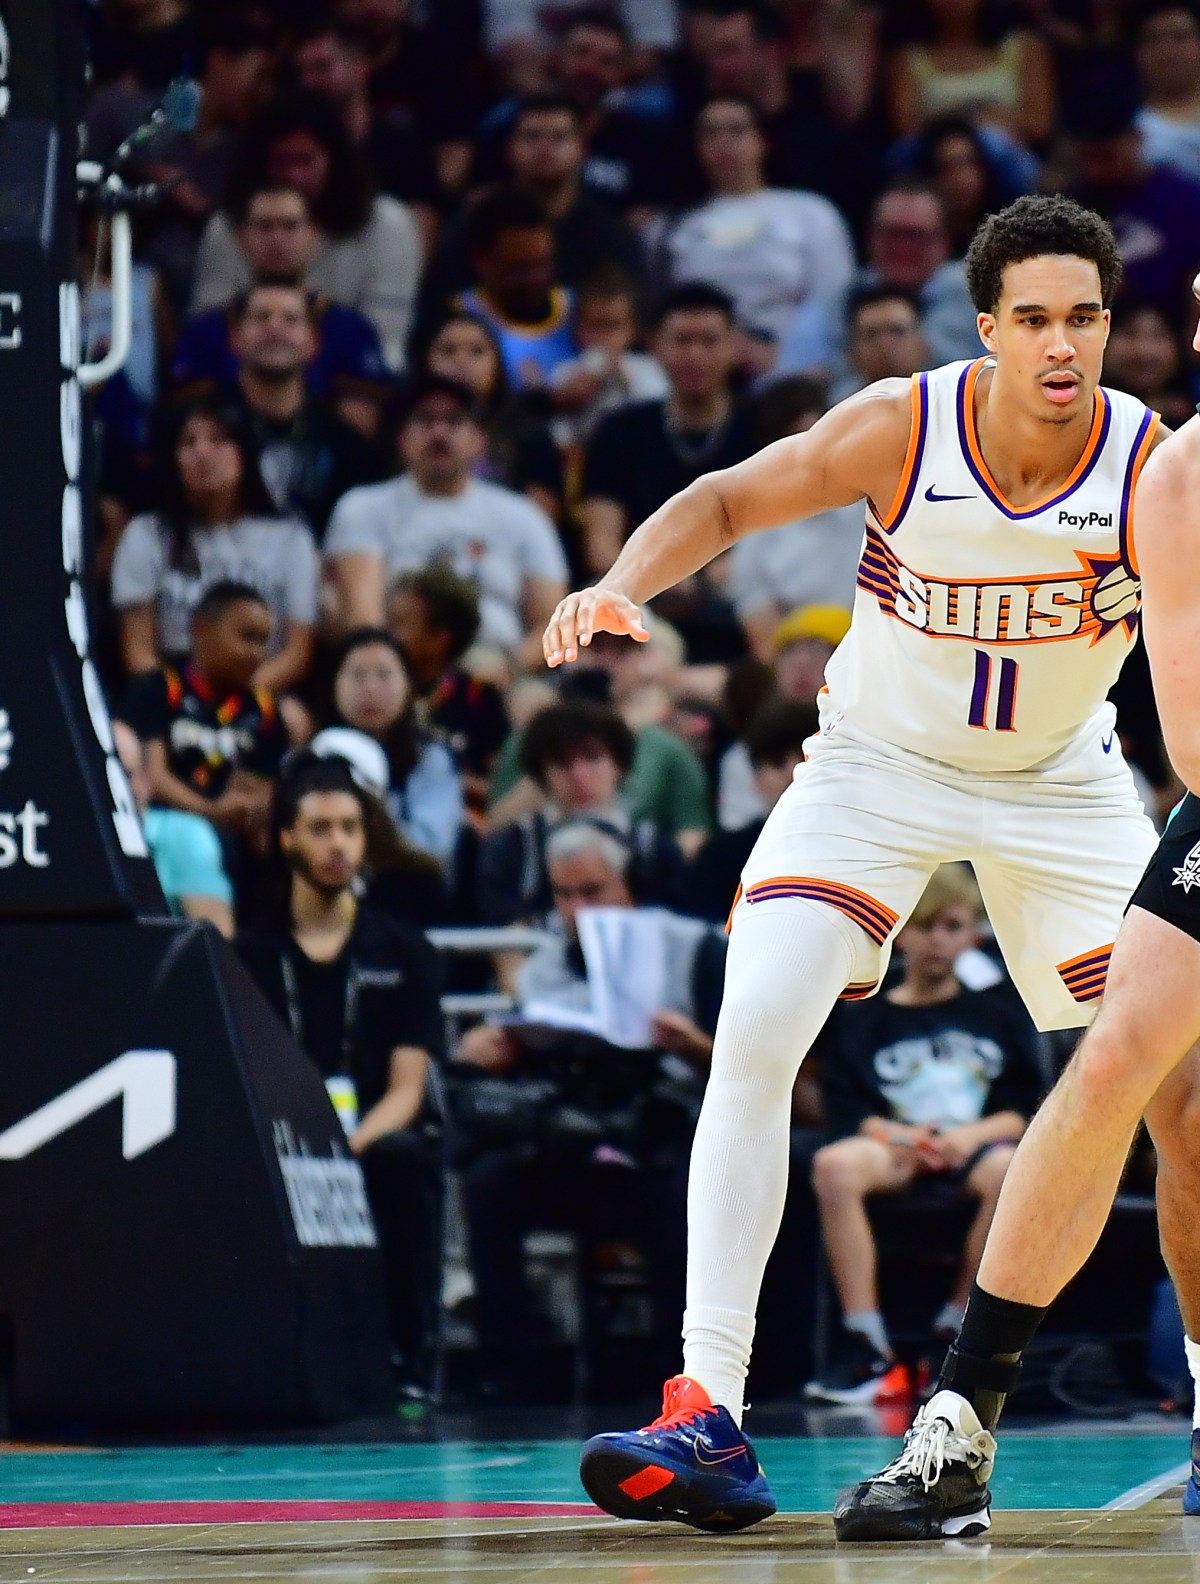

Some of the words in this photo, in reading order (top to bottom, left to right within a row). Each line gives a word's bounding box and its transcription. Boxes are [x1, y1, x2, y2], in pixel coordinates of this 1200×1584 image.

[1058, 511, 1112, 530] PayPal
[895, 565, 1084, 640] SUNS
[968, 648, 1020, 732] 11
